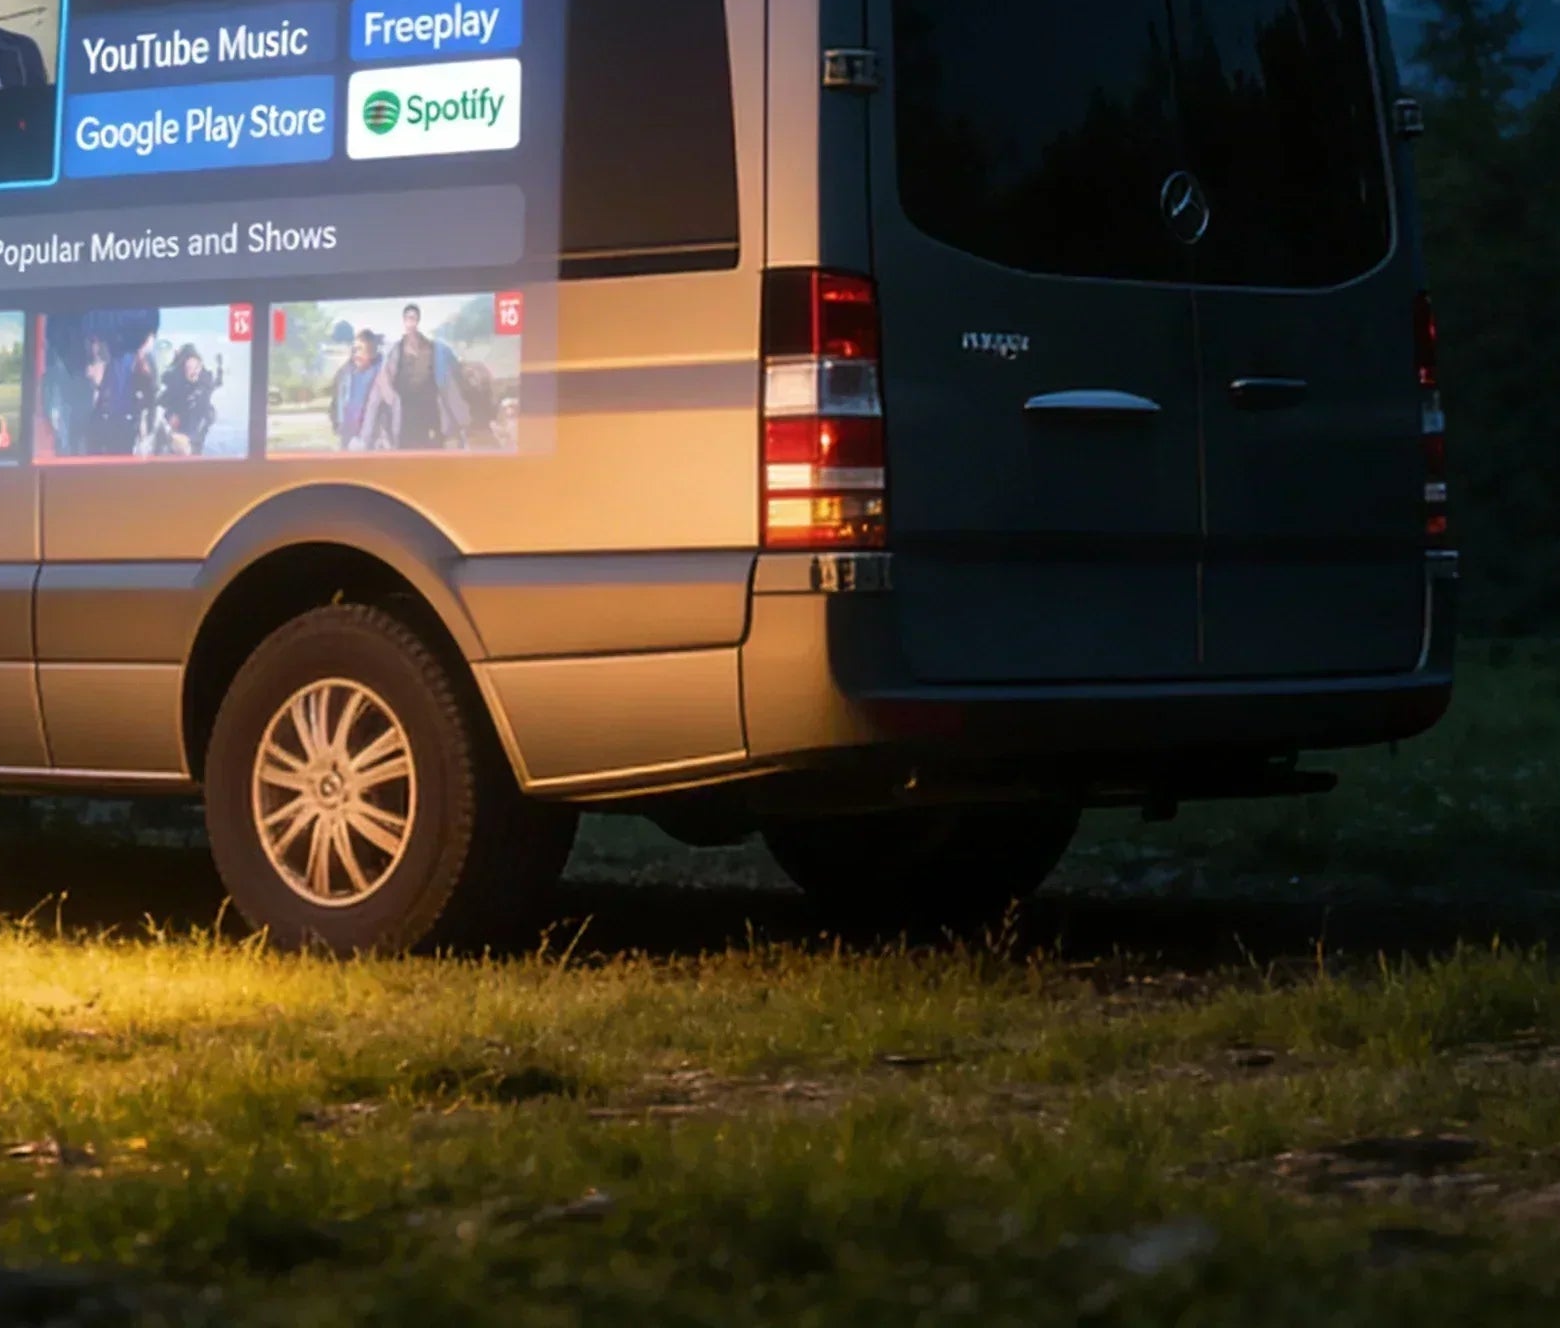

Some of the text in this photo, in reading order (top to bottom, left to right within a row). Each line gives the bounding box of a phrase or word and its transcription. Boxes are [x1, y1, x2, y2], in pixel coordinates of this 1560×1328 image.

[82, 19, 309, 73] YouTube Music
[364, 0, 500, 48] Freeplay
[76, 102, 327, 155] Google Play Store
[406, 85, 505, 130] Spotify
[90, 227, 180, 261] Movies
[187, 221, 238, 256] and
[248, 218, 337, 252] Shows
